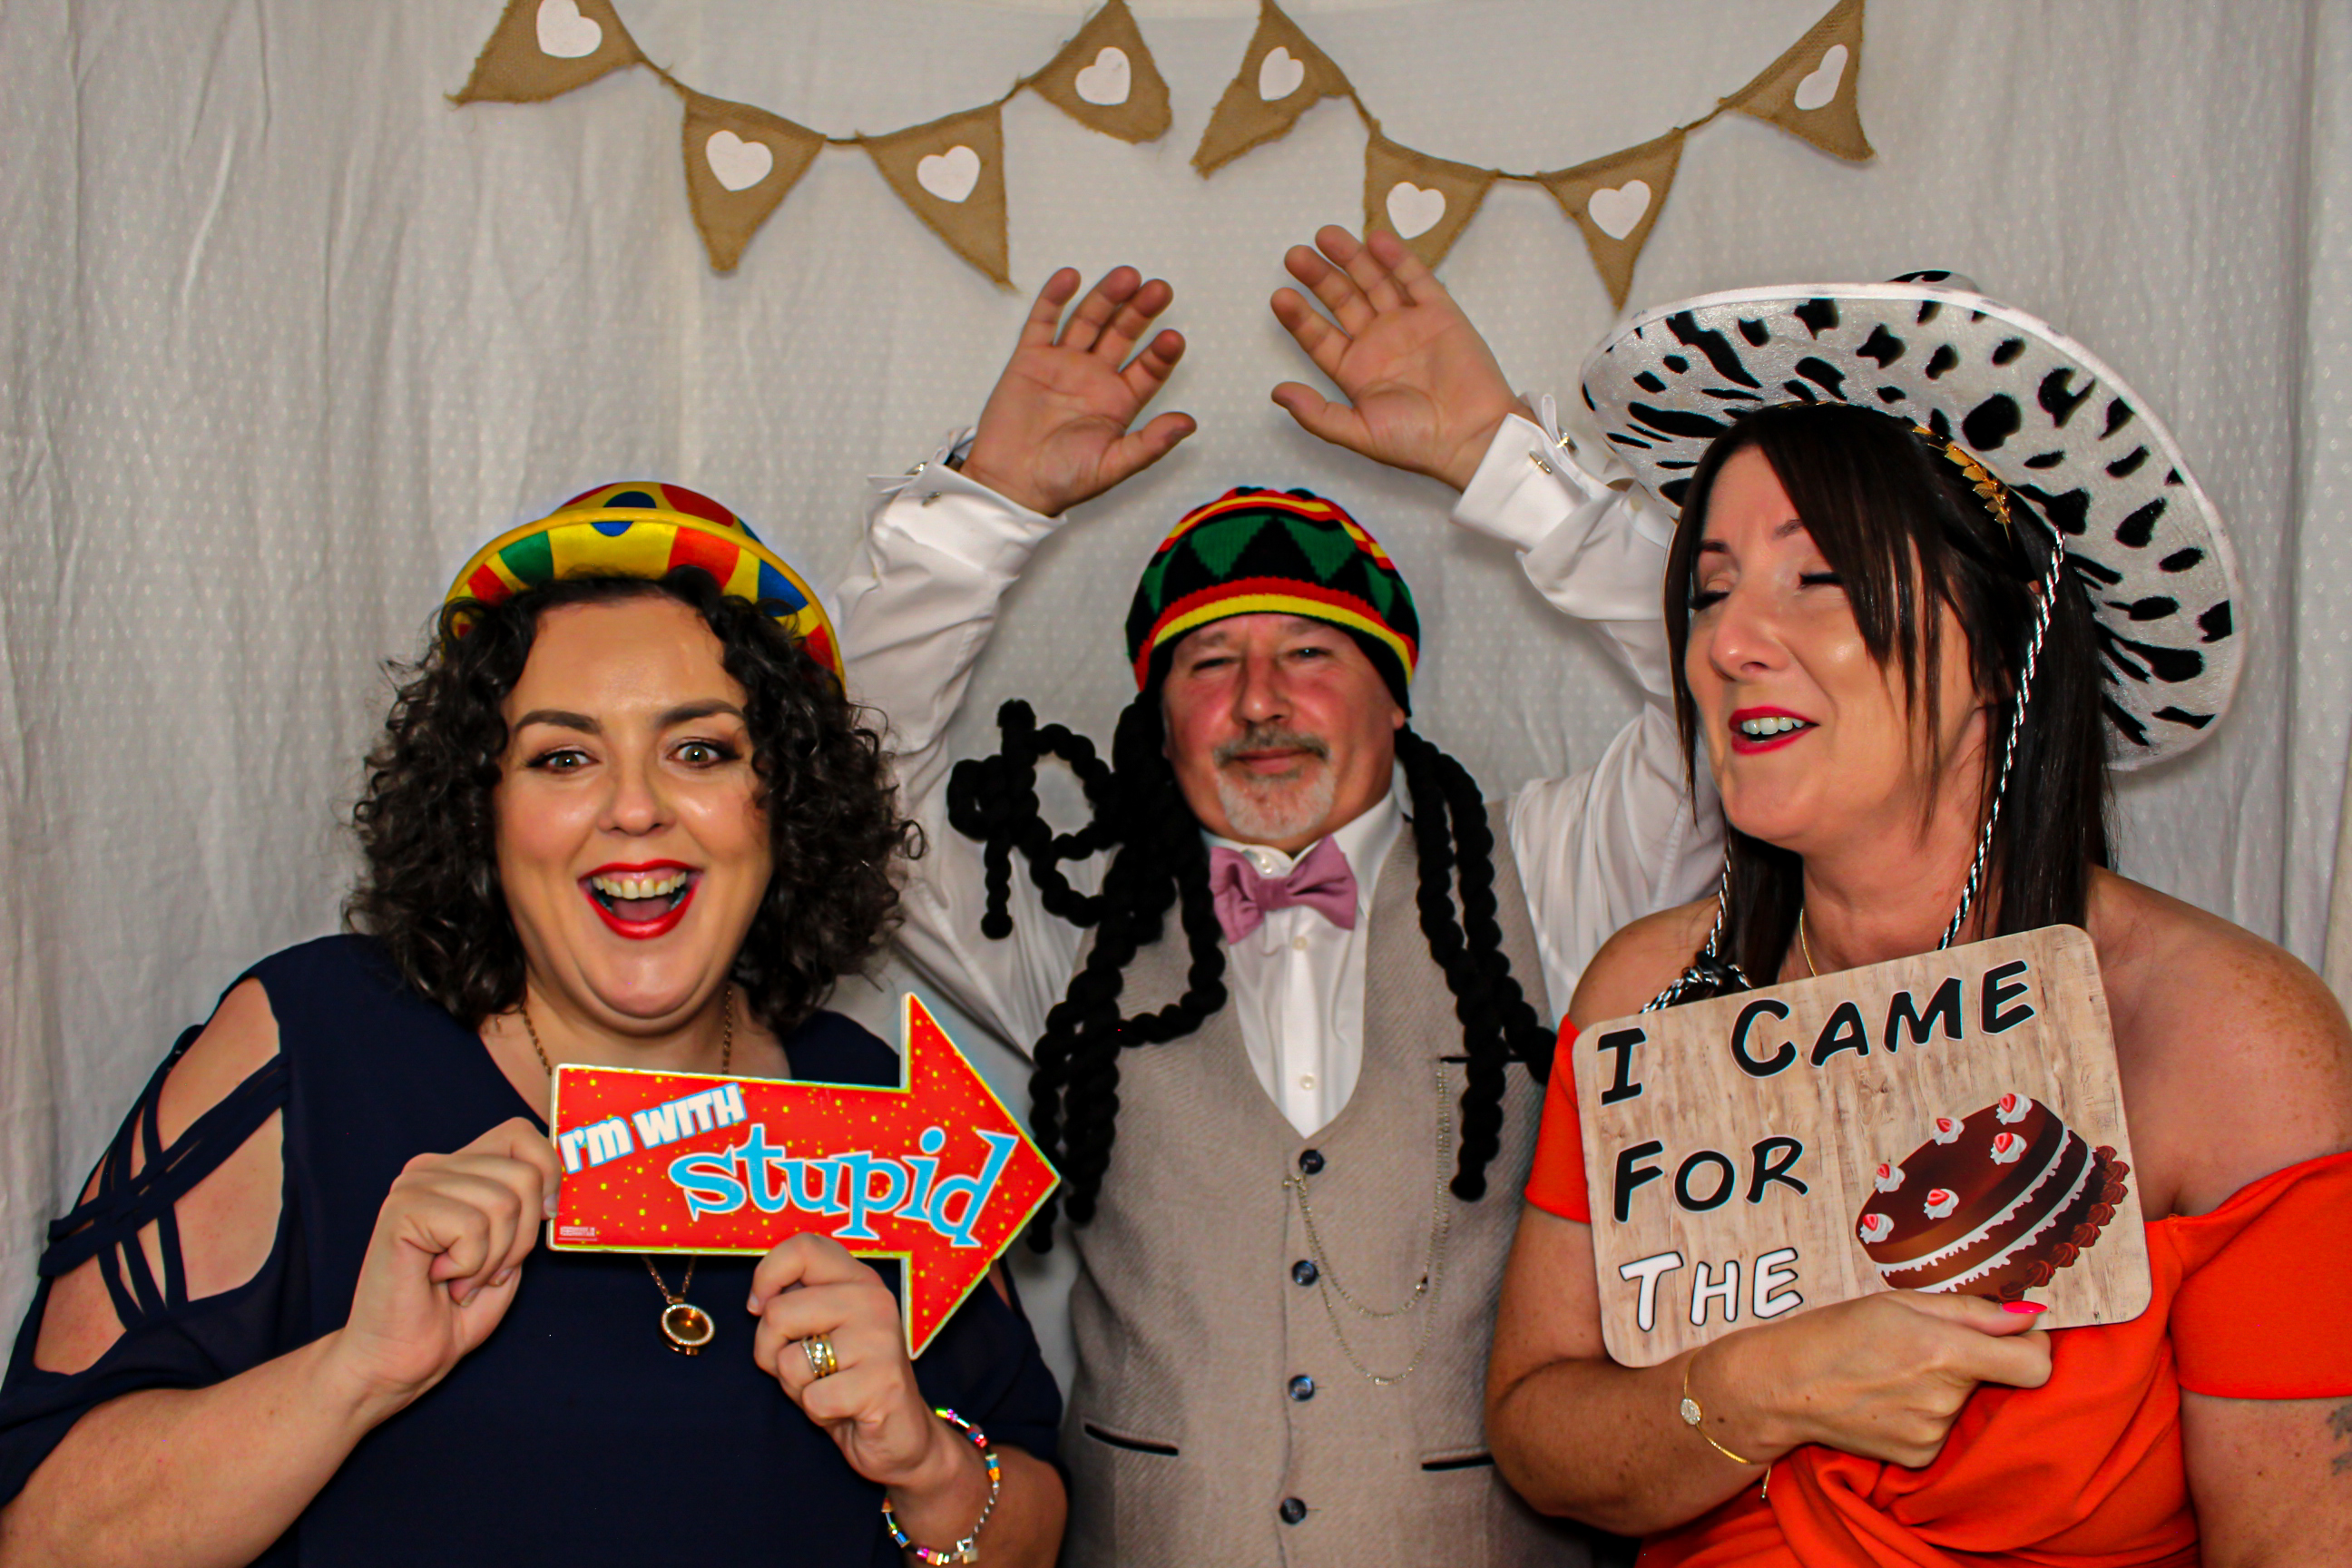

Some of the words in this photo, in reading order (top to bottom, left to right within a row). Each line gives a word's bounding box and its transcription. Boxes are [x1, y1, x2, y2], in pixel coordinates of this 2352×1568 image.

[1596, 1026, 1646, 1106] I
[1730, 959, 2035, 1077] CAME
[632, 1083, 748, 1150] WITH
[669, 1123, 1019, 1248] stupid
[1613, 1135, 1809, 1223] FOR
[1620, 1248, 1804, 1333] THE
